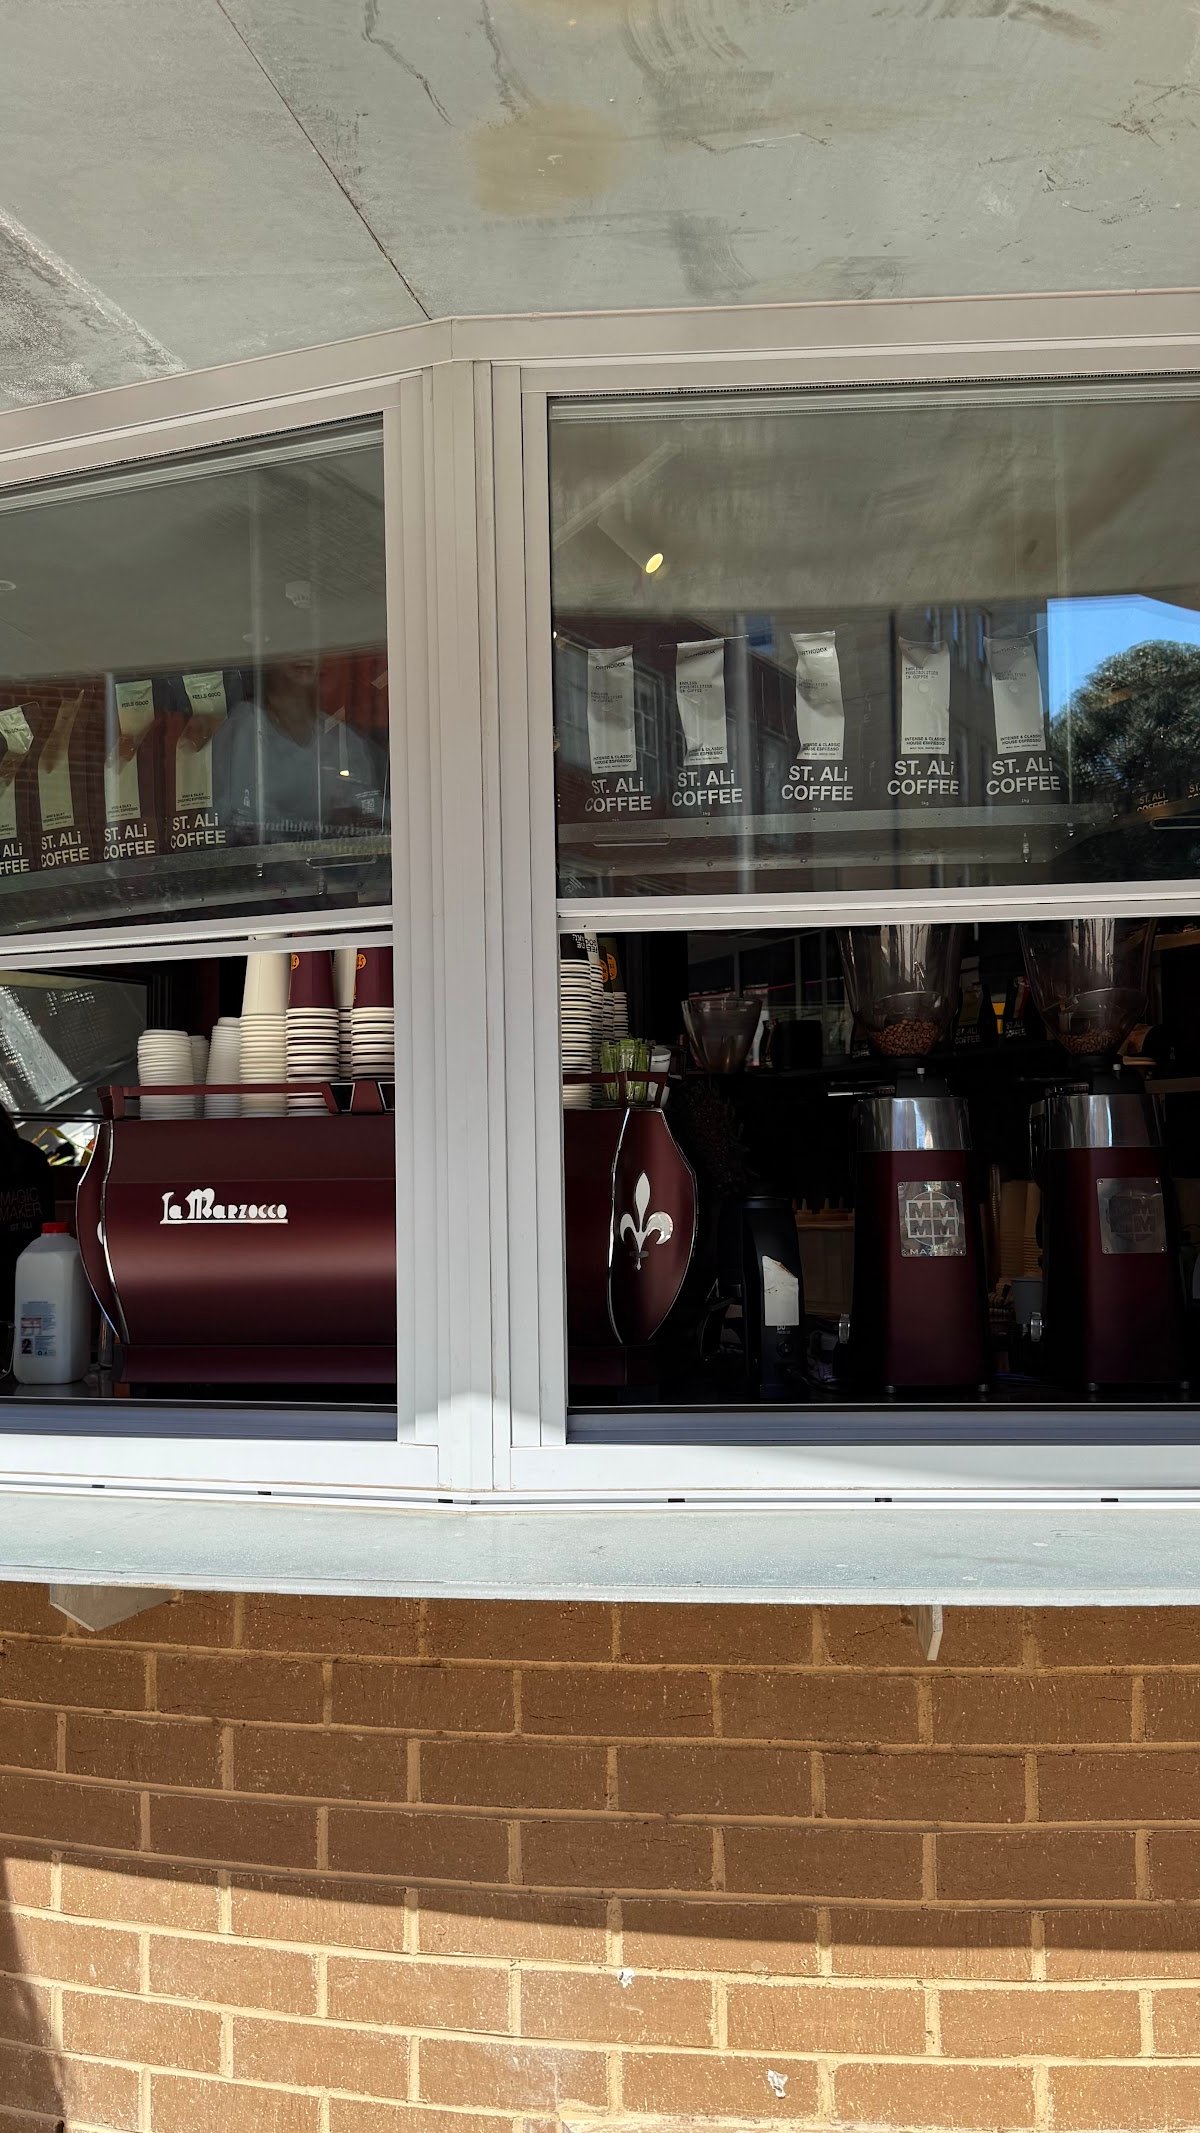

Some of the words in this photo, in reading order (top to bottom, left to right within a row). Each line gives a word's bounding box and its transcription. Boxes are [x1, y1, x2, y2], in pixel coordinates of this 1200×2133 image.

[789, 766, 814, 781] ST.
[820, 766, 848, 782] ALi
[894, 760, 921, 775] ST.
[927, 760, 954, 775] ALi
[992, 758, 1020, 776] ST.
[1025, 757, 1052, 772] ALi
[592, 779, 610, 794] ST.
[616, 777, 644, 792] ALi
[678, 771, 700, 787] ST.
[706, 769, 735, 785] ALi
[886, 779, 959, 795] COFFEE
[986, 776, 1061, 795] COFFEE
[671, 788, 743, 806] COFFEE
[781, 784, 854, 801] COFFEE
[585, 796, 652, 812] COFFEE
[172, 815, 190, 831] ST.
[194, 812, 219, 827] ALi
[41, 836, 56, 850] ST.
[60, 831, 81, 847] ALi
[104, 826, 121, 842] ST.
[124, 824, 148, 839] ALi
[170, 830, 226, 849] COFFEE
[41, 847, 90, 868] COFFEE
[103, 840, 156, 860] COFFEE
[160, 1192, 183, 1223] La
[184, 1188, 288, 1219] Marzocco
